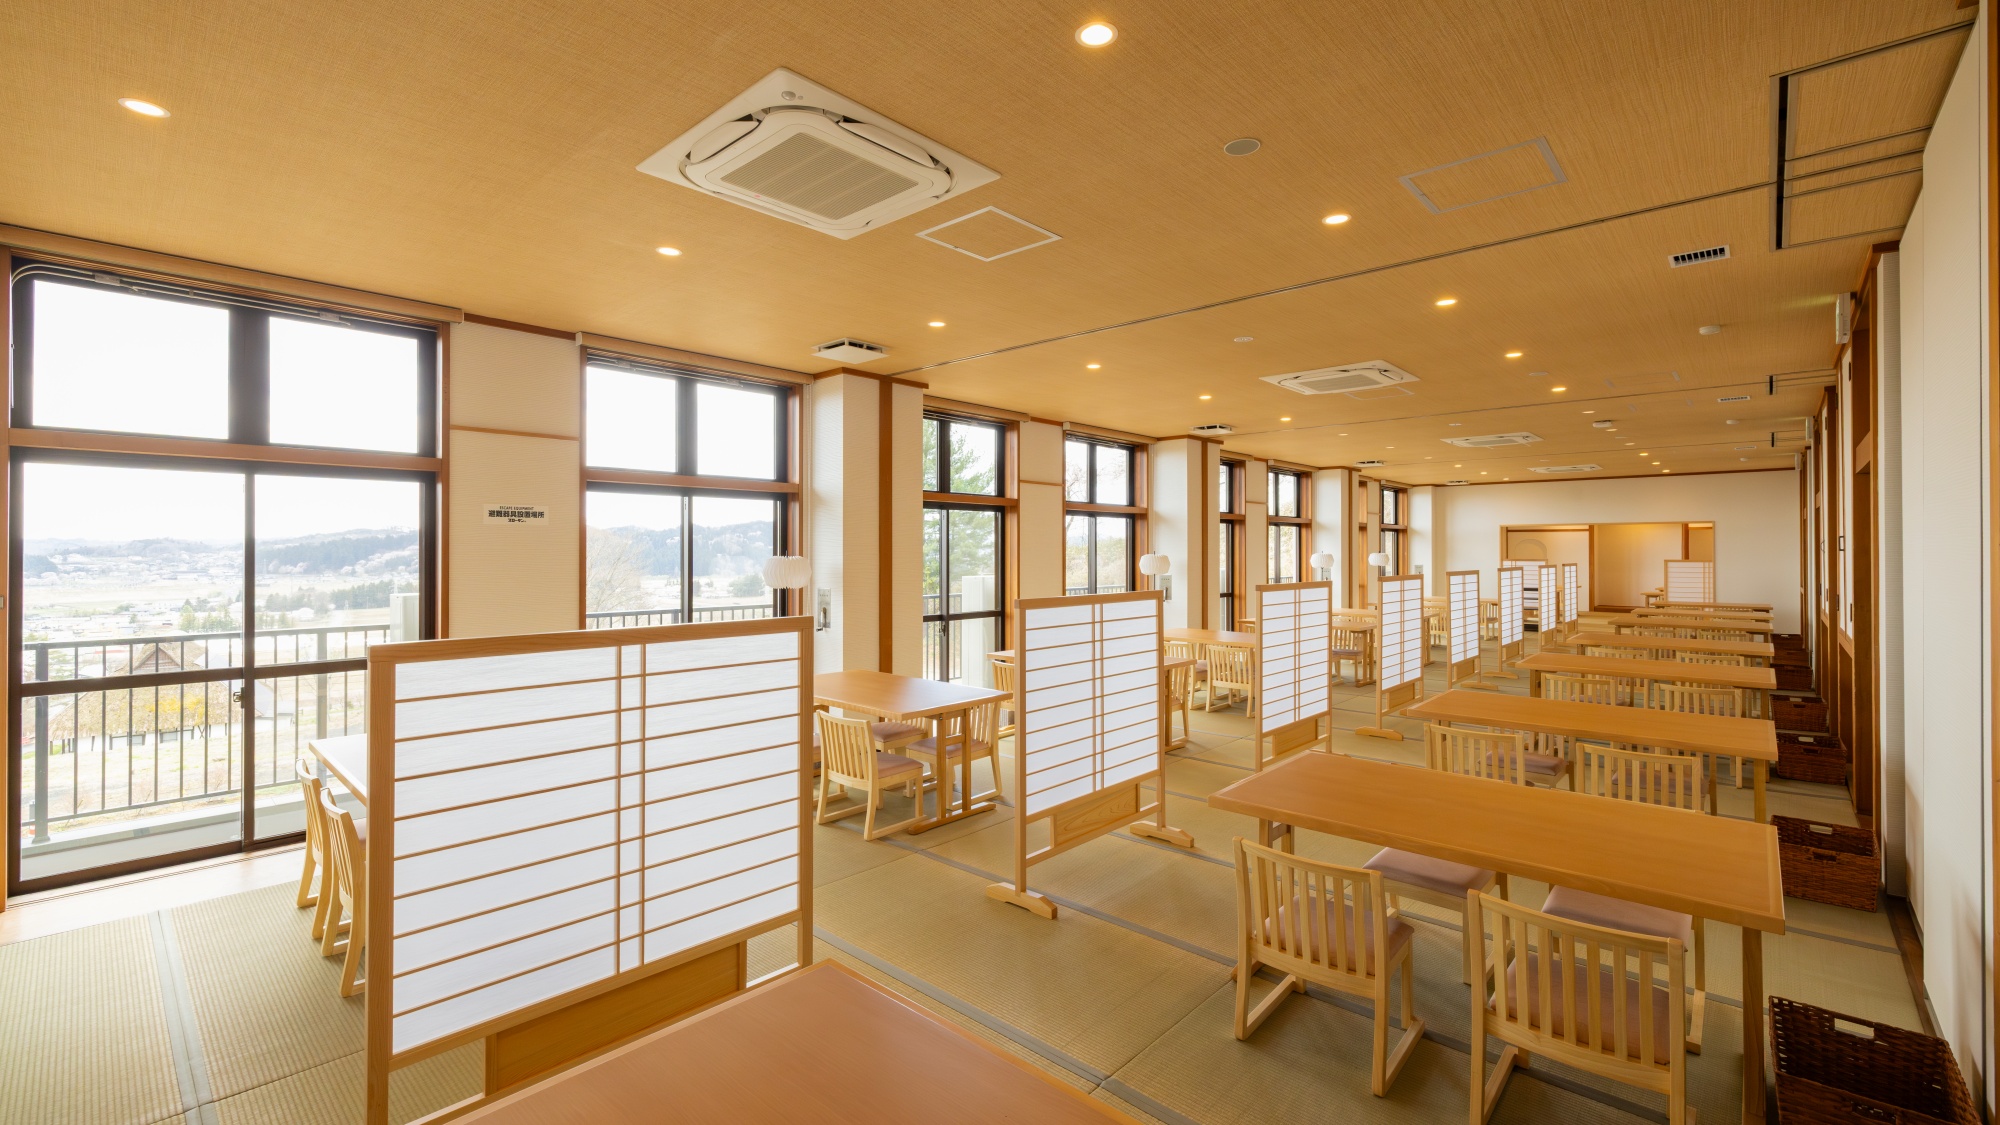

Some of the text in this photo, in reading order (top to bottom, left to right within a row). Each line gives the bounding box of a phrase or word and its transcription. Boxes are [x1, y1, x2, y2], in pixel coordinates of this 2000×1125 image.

[488, 510, 544, 518] 避難器具設置場所
